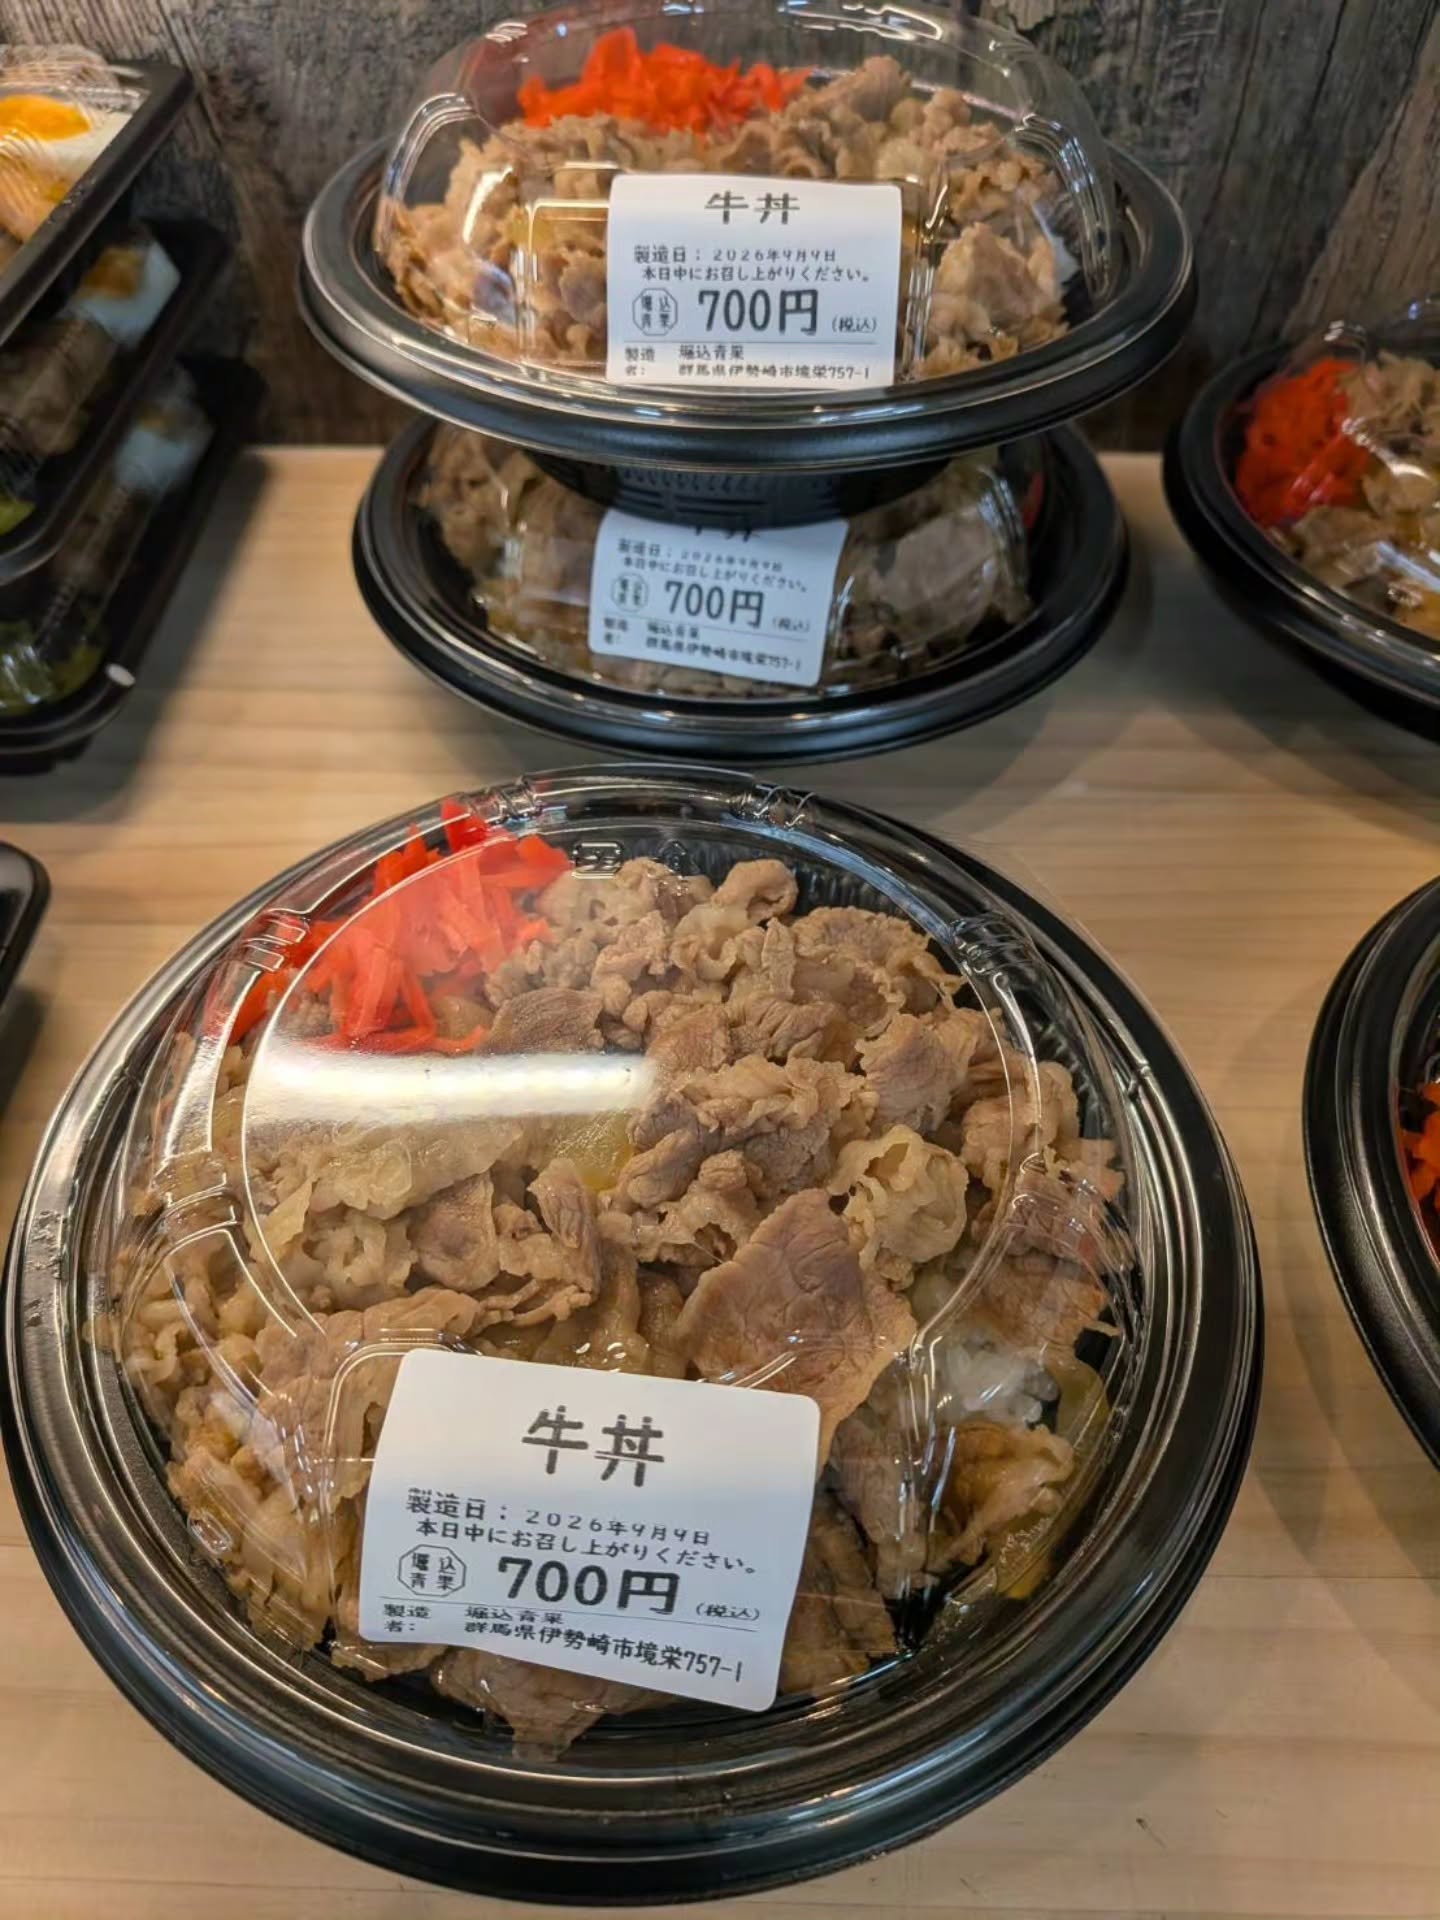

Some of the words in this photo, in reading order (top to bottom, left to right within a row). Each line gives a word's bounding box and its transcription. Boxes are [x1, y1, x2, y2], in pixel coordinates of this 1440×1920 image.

[704, 190, 800, 225] 牛丼
[698, 288, 818, 336] 700円
[664, 579, 765, 629] 700円
[522, 1404, 665, 1488] 牛丼
[416, 1518, 757, 1573] 本日中にお召し上がりください。
[498, 1555, 681, 1616] 700円
